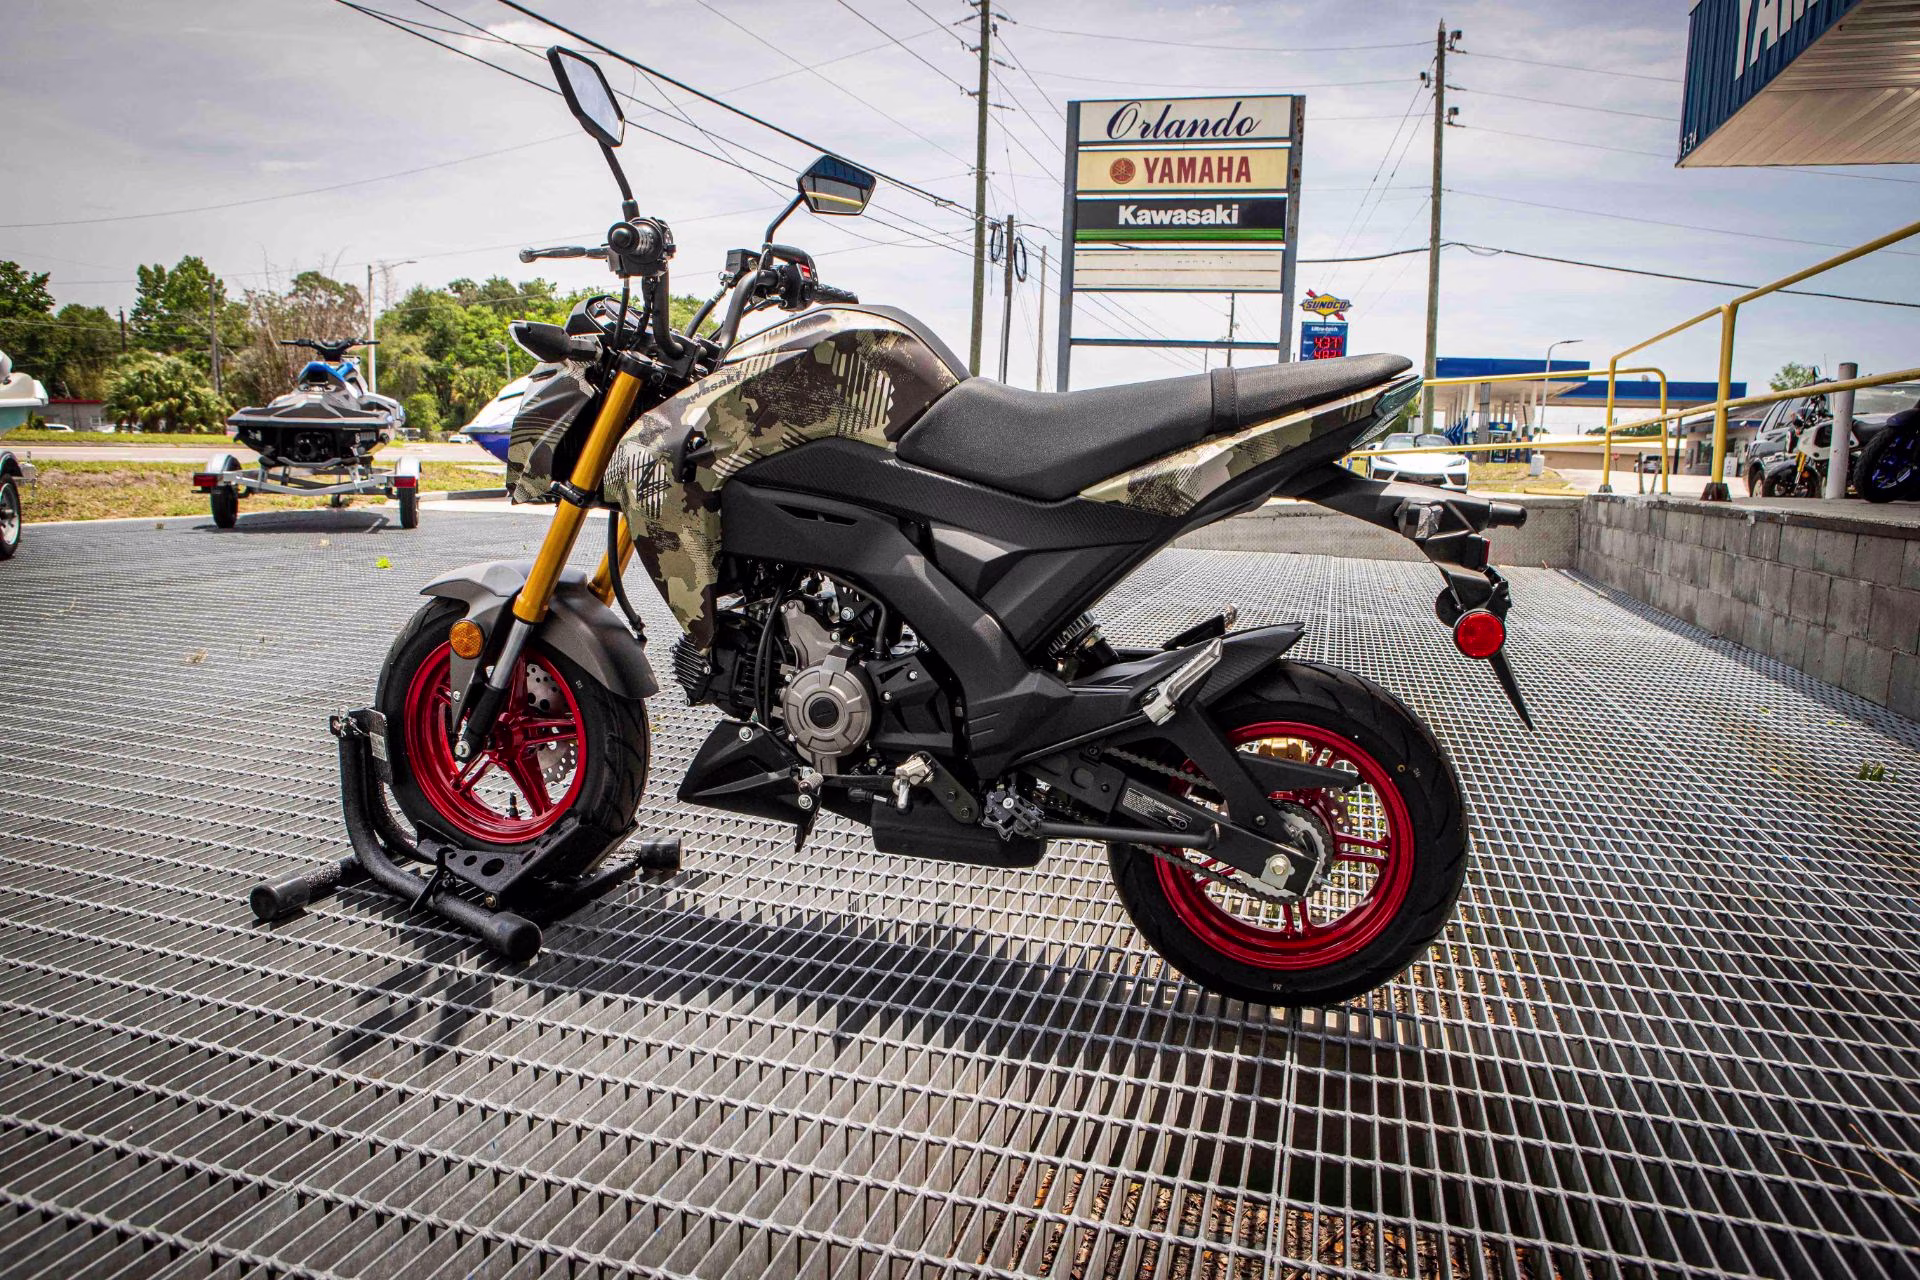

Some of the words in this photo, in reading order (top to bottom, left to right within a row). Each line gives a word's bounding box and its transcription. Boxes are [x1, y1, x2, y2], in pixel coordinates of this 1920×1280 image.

[1106, 101, 1262, 140] Orlando
[1143, 156, 1252, 184] YAMAHA
[1118, 204, 1239, 225] Kawasaki
[1305, 301, 1346, 309] SUNOCO
